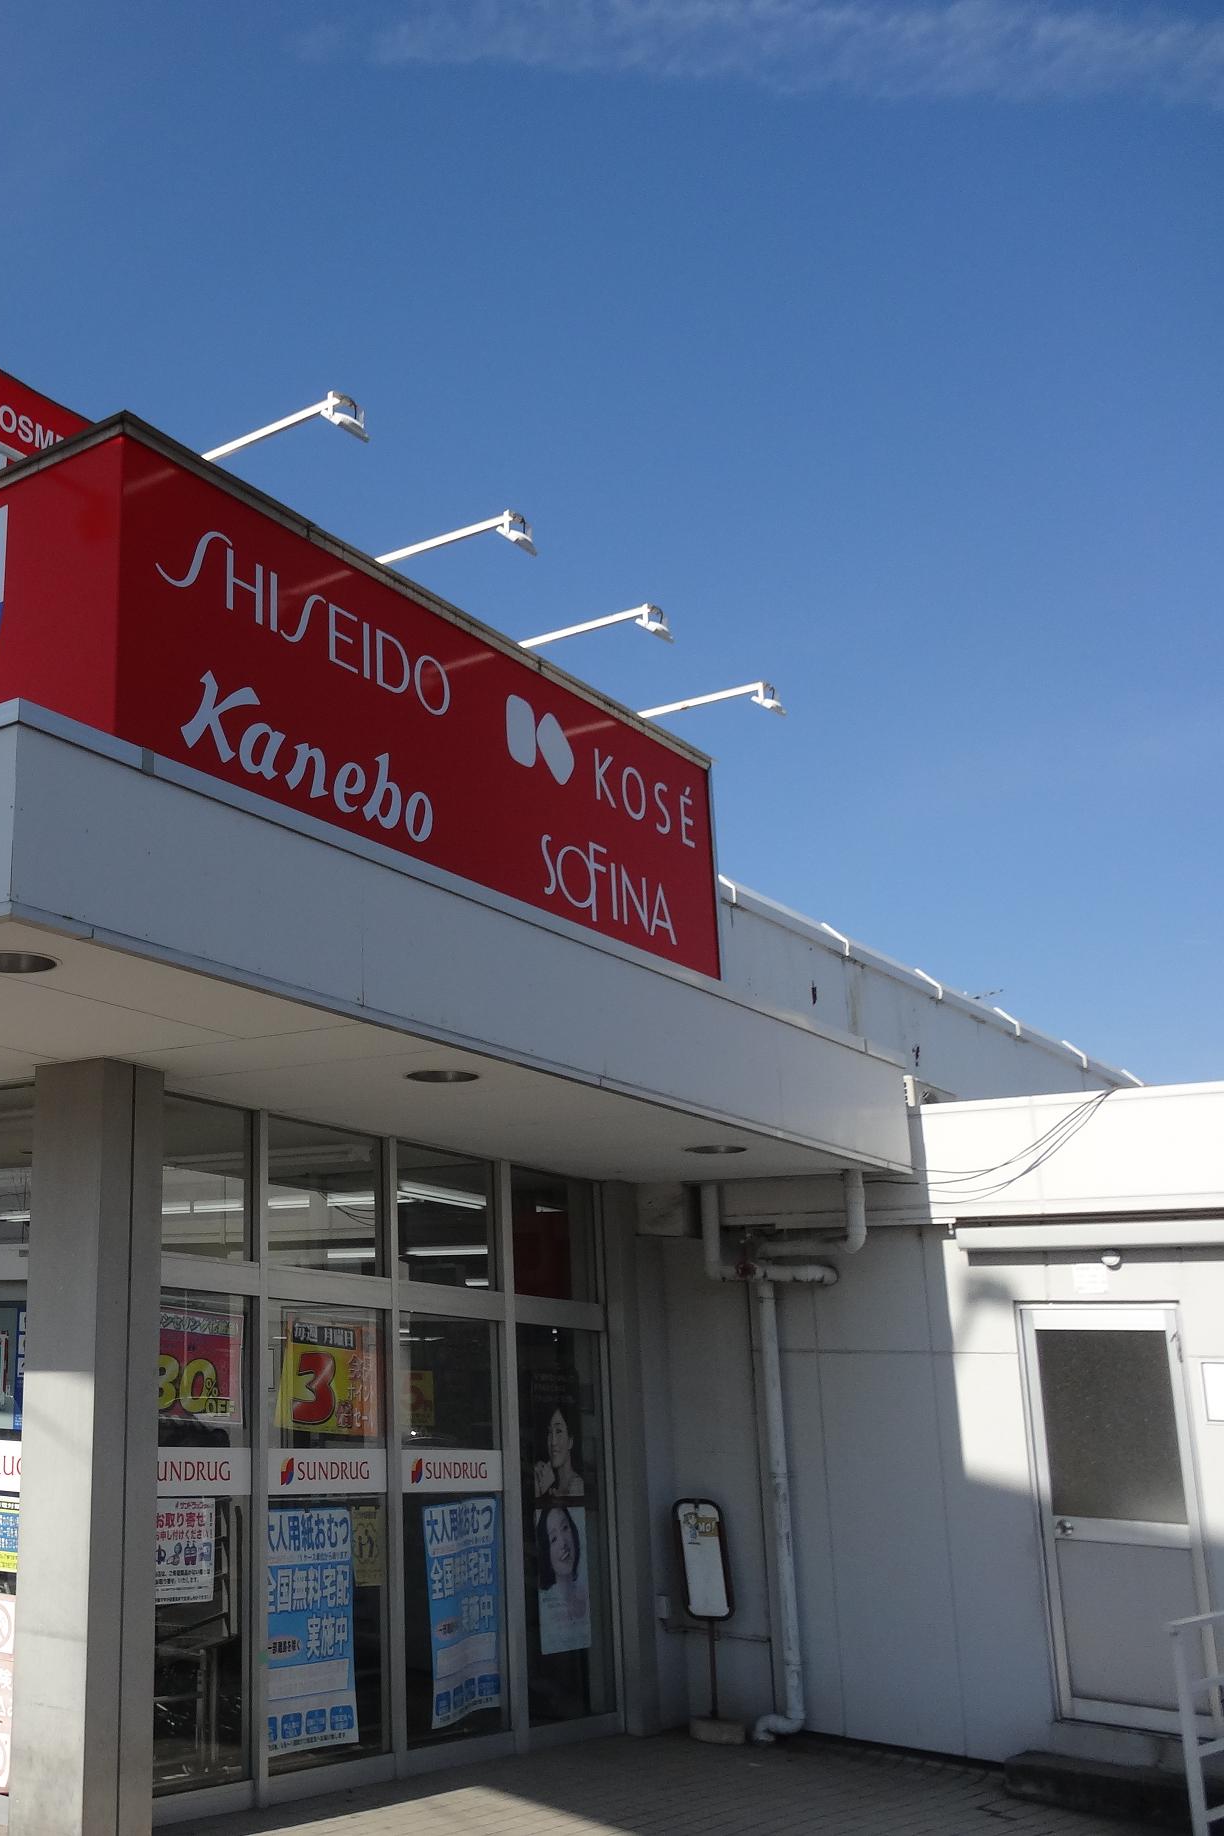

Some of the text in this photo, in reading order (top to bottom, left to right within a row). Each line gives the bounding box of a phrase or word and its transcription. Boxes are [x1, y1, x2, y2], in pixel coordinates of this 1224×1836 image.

[155, 530, 451, 716] SHISEIDO
[180, 669, 434, 843] Kanebo
[592, 746, 696, 849] KOSÉ
[541, 833, 677, 946] SOFINA
[293, 1322, 355, 1348] 毎週 月曜日
[291, 1351, 336, 1423] 3
[156, 1460, 232, 1483] UNDRUG
[296, 1459, 370, 1482] SUNDRUG
[424, 1460, 488, 1481] SUNDRUG
[156, 1512, 206, 1529] お取り寄せ
[306, 1613, 348, 1660] 実施中
